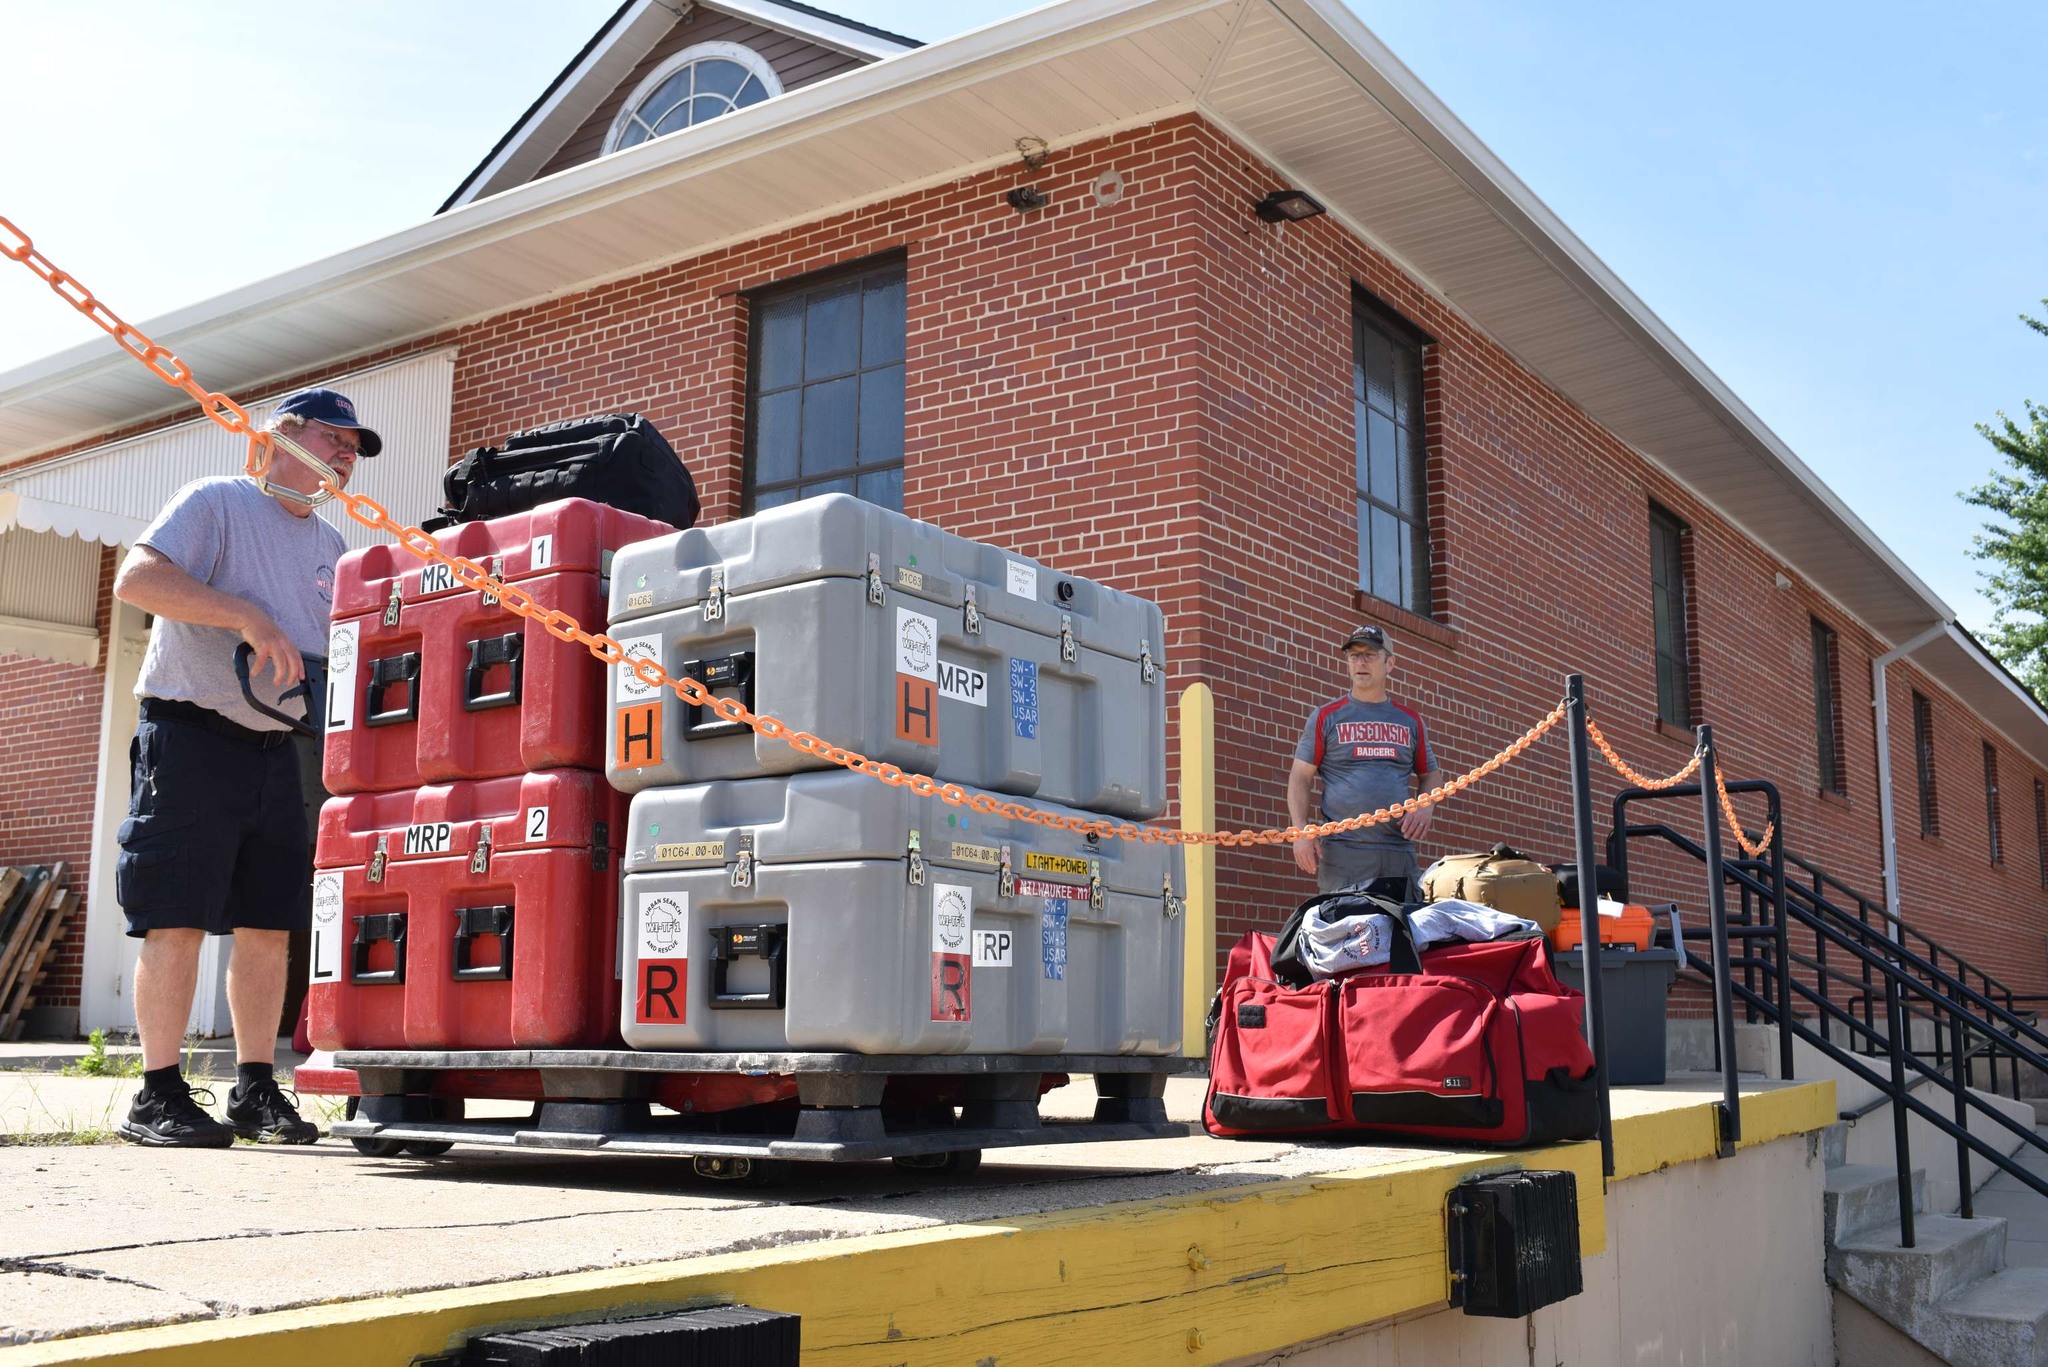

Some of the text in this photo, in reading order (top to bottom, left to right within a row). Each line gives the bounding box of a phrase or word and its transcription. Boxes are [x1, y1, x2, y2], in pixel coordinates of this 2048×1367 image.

[538, 540, 545, 564] 1
[1010, 562, 1035, 580] Emergency
[1015, 575, 1030, 585] Decon
[1018, 586, 1026, 594] Kit
[342, 627, 355, 641] SEARCH
[902, 617, 932, 640] URBAN SEARCH
[625, 641, 657, 657] RBAN SEARCH
[904, 655, 930, 672] AND RESCUE
[1011, 659, 1035, 676] SW-1
[624, 684, 651, 694] AND RESCU
[938, 662, 984, 698] MRP
[1011, 674, 1036, 693] SW-2
[328, 682, 346, 728] L
[1012, 690, 1037, 707] SW-3
[904, 681, 931, 739] H
[1013, 705, 1037, 724] USAR
[624, 708, 653, 763] H
[1336, 721, 1411, 748] WISCONSIN
[1357, 747, 1396, 757] BADGERS
[530, 809, 545, 838] 2
[406, 823, 450, 854] MRP
[1026, 853, 1088, 875] LIGHT+POWER
[327, 875, 341, 890] SEARCH
[1019, 880, 1073, 899] MILWAUKEE
[645, 897, 682, 916] URBAN SEARCH
[952, 890, 967, 910] SEARCH
[1044, 899, 1067, 914] SW-1
[322, 912, 337, 923] RESCUE
[1043, 914, 1066, 929] SW-2
[646, 939, 678, 954] AND RESCUE
[940, 933, 964, 948] AND RESCUE
[1043, 930, 1066, 946] SW-3
[314, 930, 333, 978] L
[1043, 948, 1066, 963] USAR
[645, 964, 680, 1019] R
[939, 960, 967, 1015] R
[1446, 1078, 1462, 1087] 5.11
